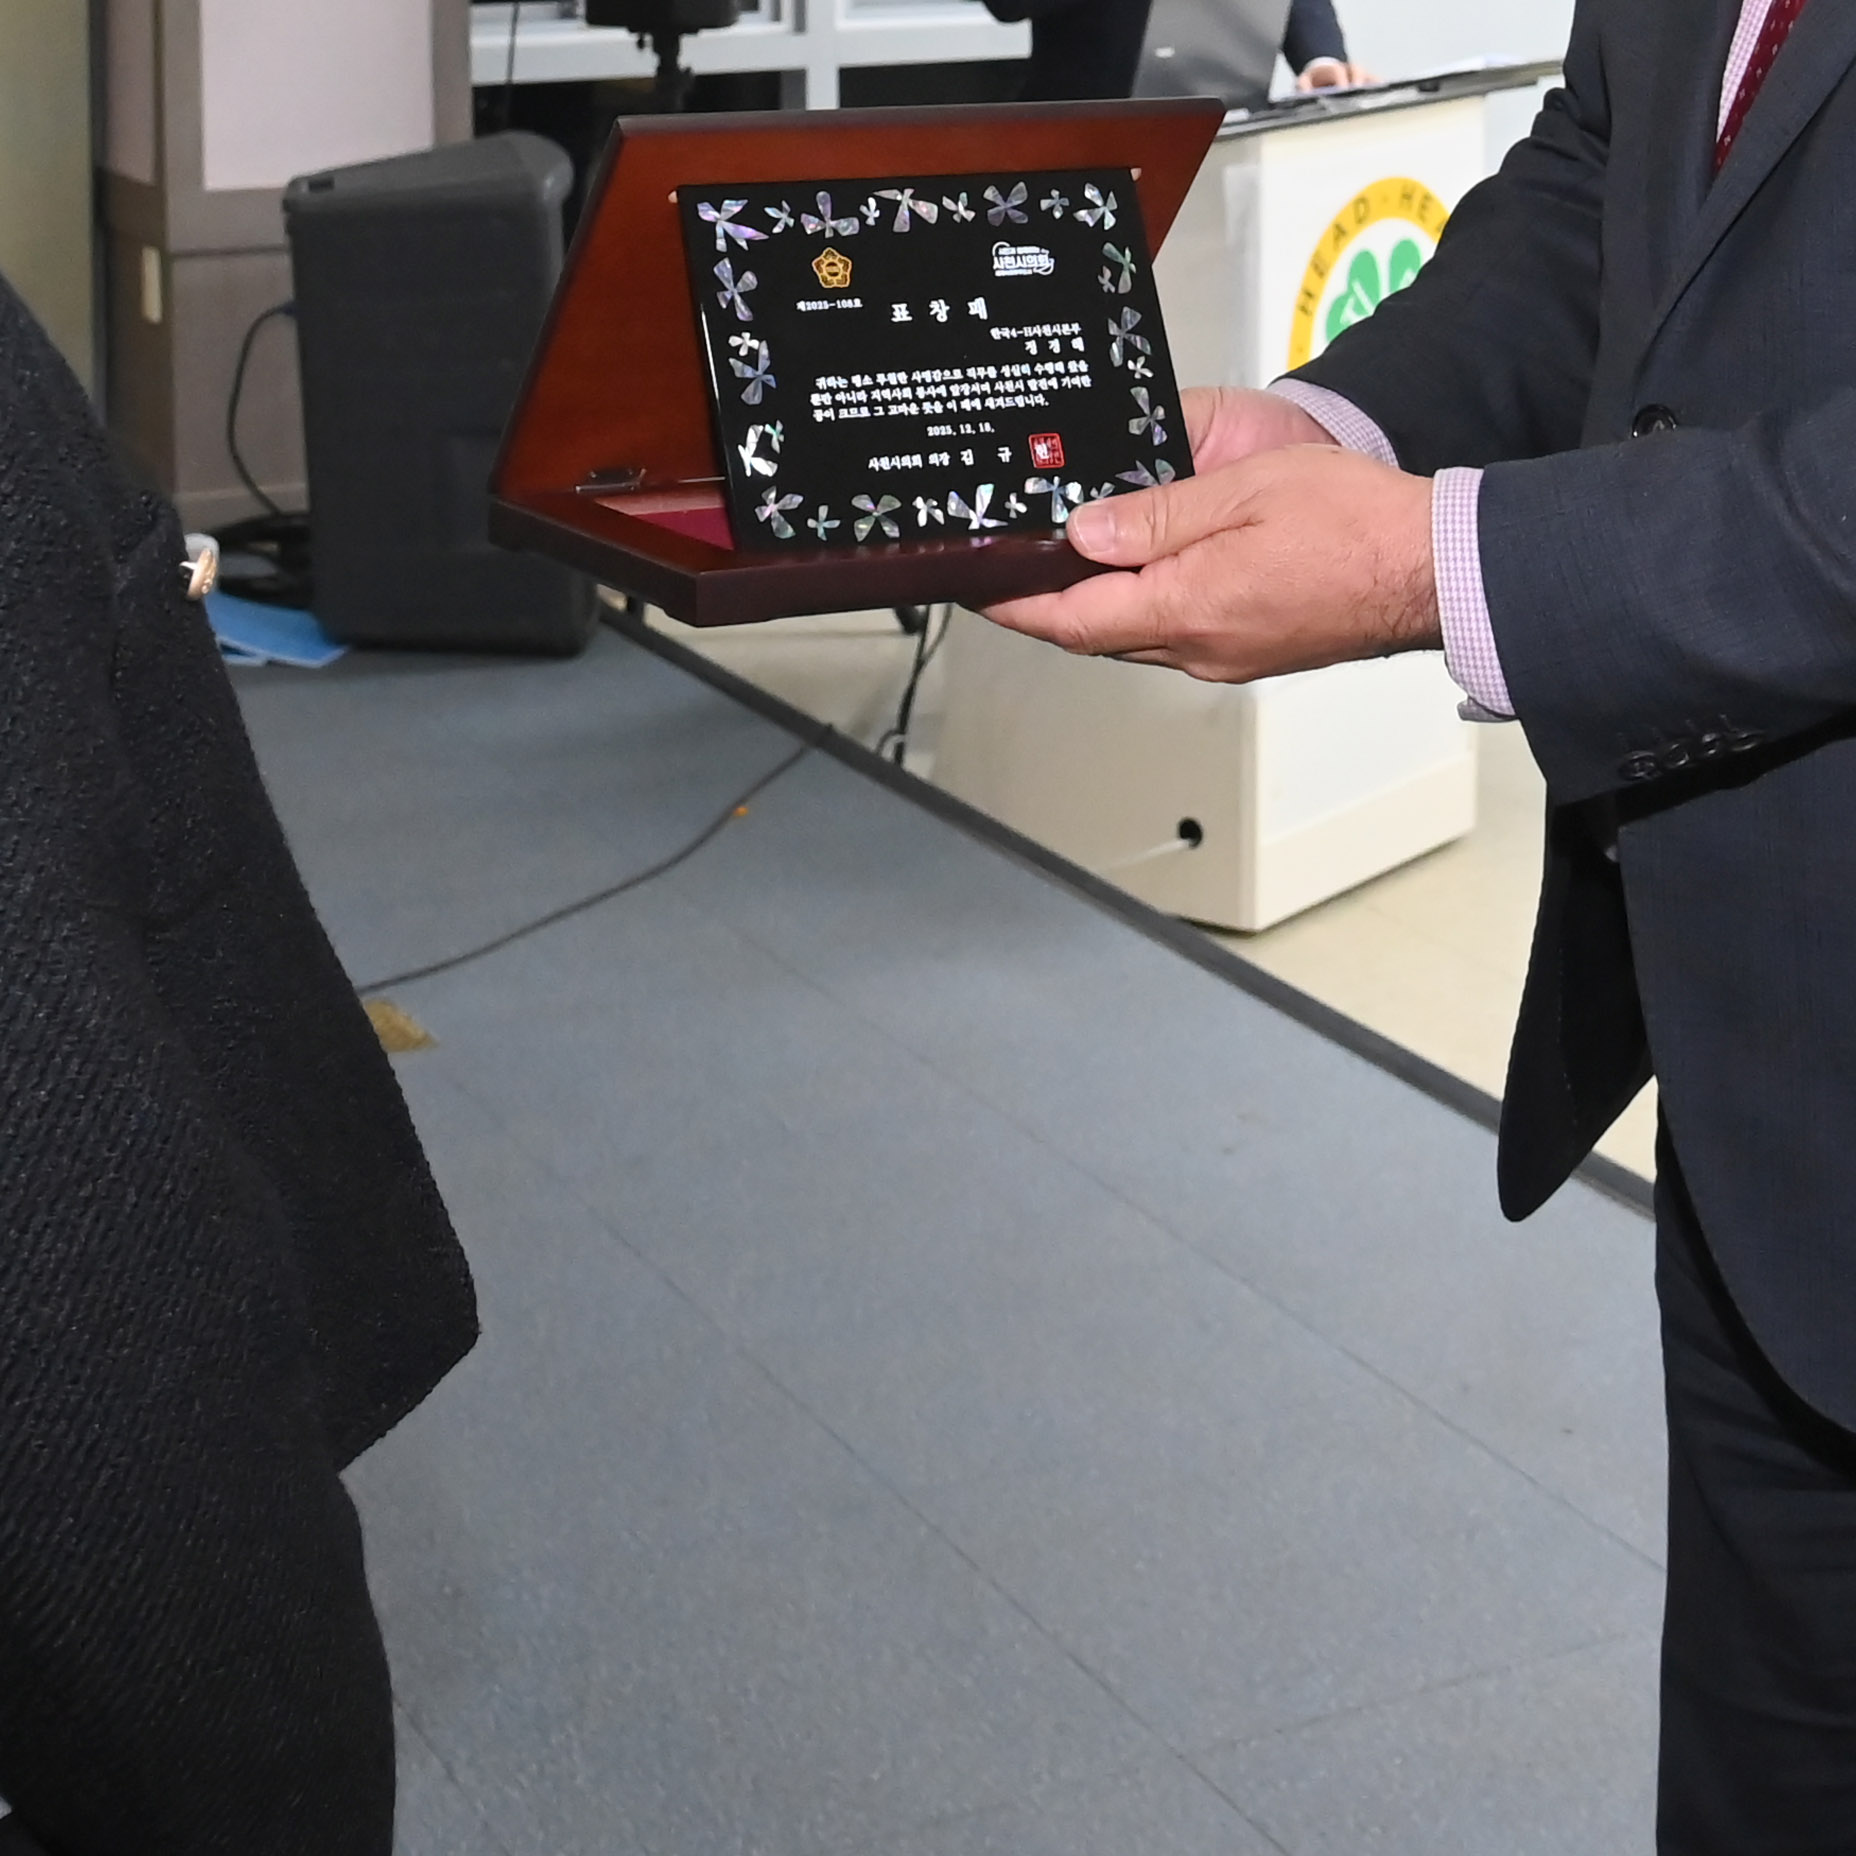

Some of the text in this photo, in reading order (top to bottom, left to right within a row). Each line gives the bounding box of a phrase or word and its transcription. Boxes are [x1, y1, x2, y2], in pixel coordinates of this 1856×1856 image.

[992, 254, 1050, 270] 사천시의회
[815, 376, 849, 390] 귀하는
[834, 389, 868, 405] 아니라
[870, 387, 913, 402] 지역사회
[994, 378, 1026, 394] 사천시
[873, 406, 885, 416] 그
[887, 402, 920, 417] 고마운
[946, 398, 958, 413] 이
[868, 453, 923, 472] 사천시의회
[928, 452, 951, 467] 의장
[960, 448, 974, 466] 김
[997, 446, 1012, 463] 규
